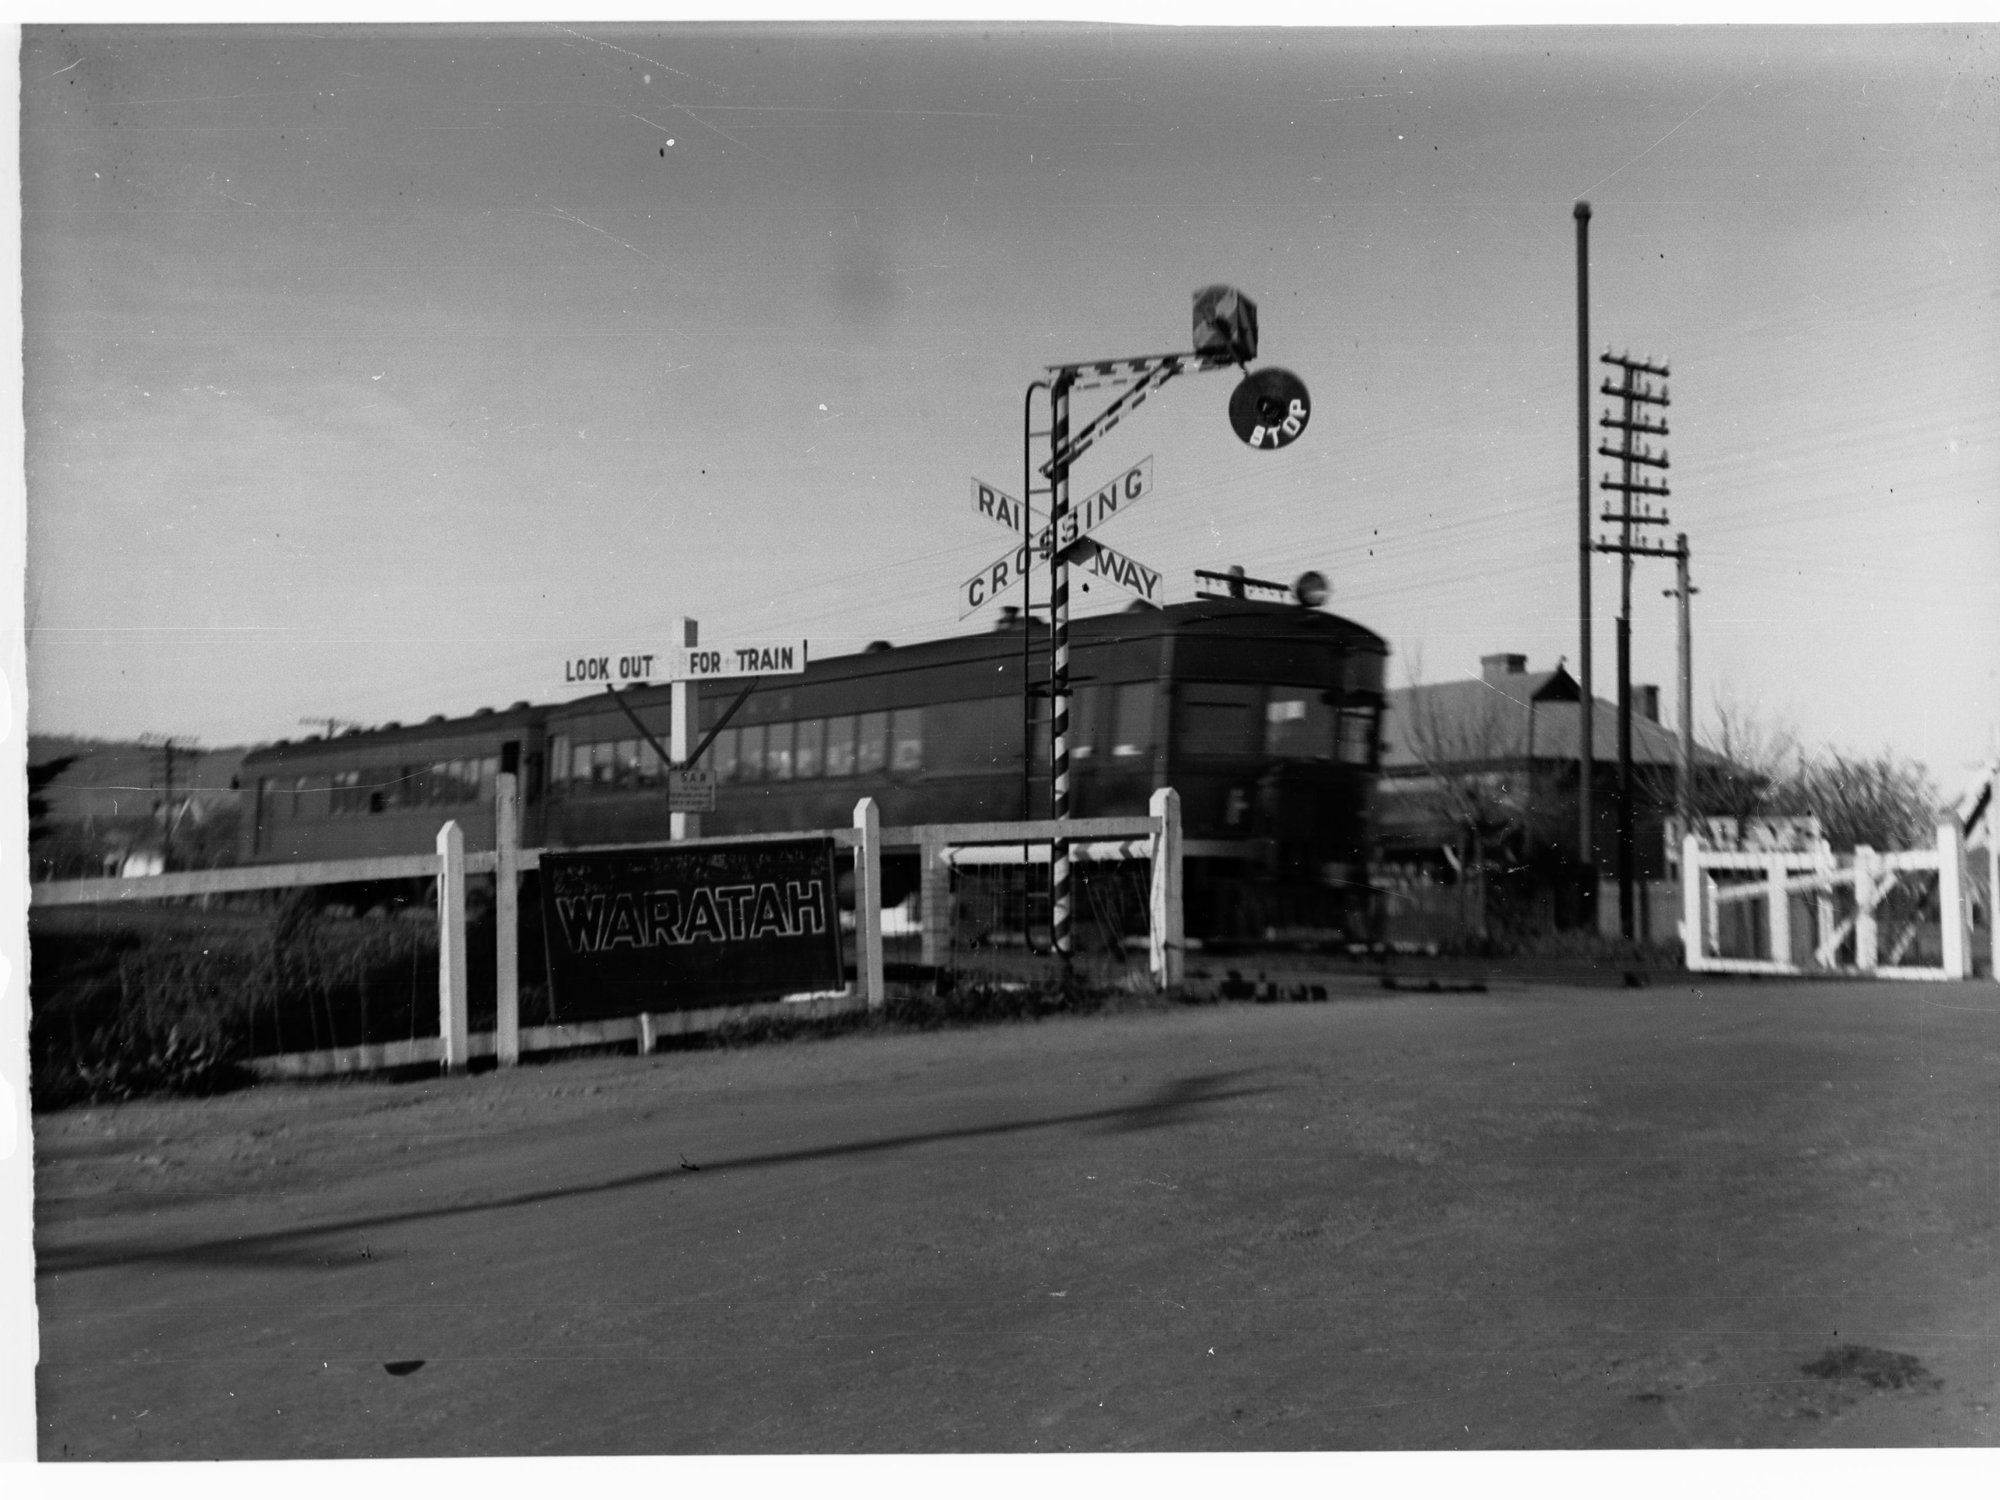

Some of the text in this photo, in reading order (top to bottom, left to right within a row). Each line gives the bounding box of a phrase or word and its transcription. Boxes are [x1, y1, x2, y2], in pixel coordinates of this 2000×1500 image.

[1249, 398, 1307, 449] STOP
[968, 468, 1143, 607] CROSSING
[978, 484, 1158, 599] RAI WAY
[566, 646, 794, 682] LOOK OUT FOR TRAIN
[556, 879, 827, 953] WARATAH
